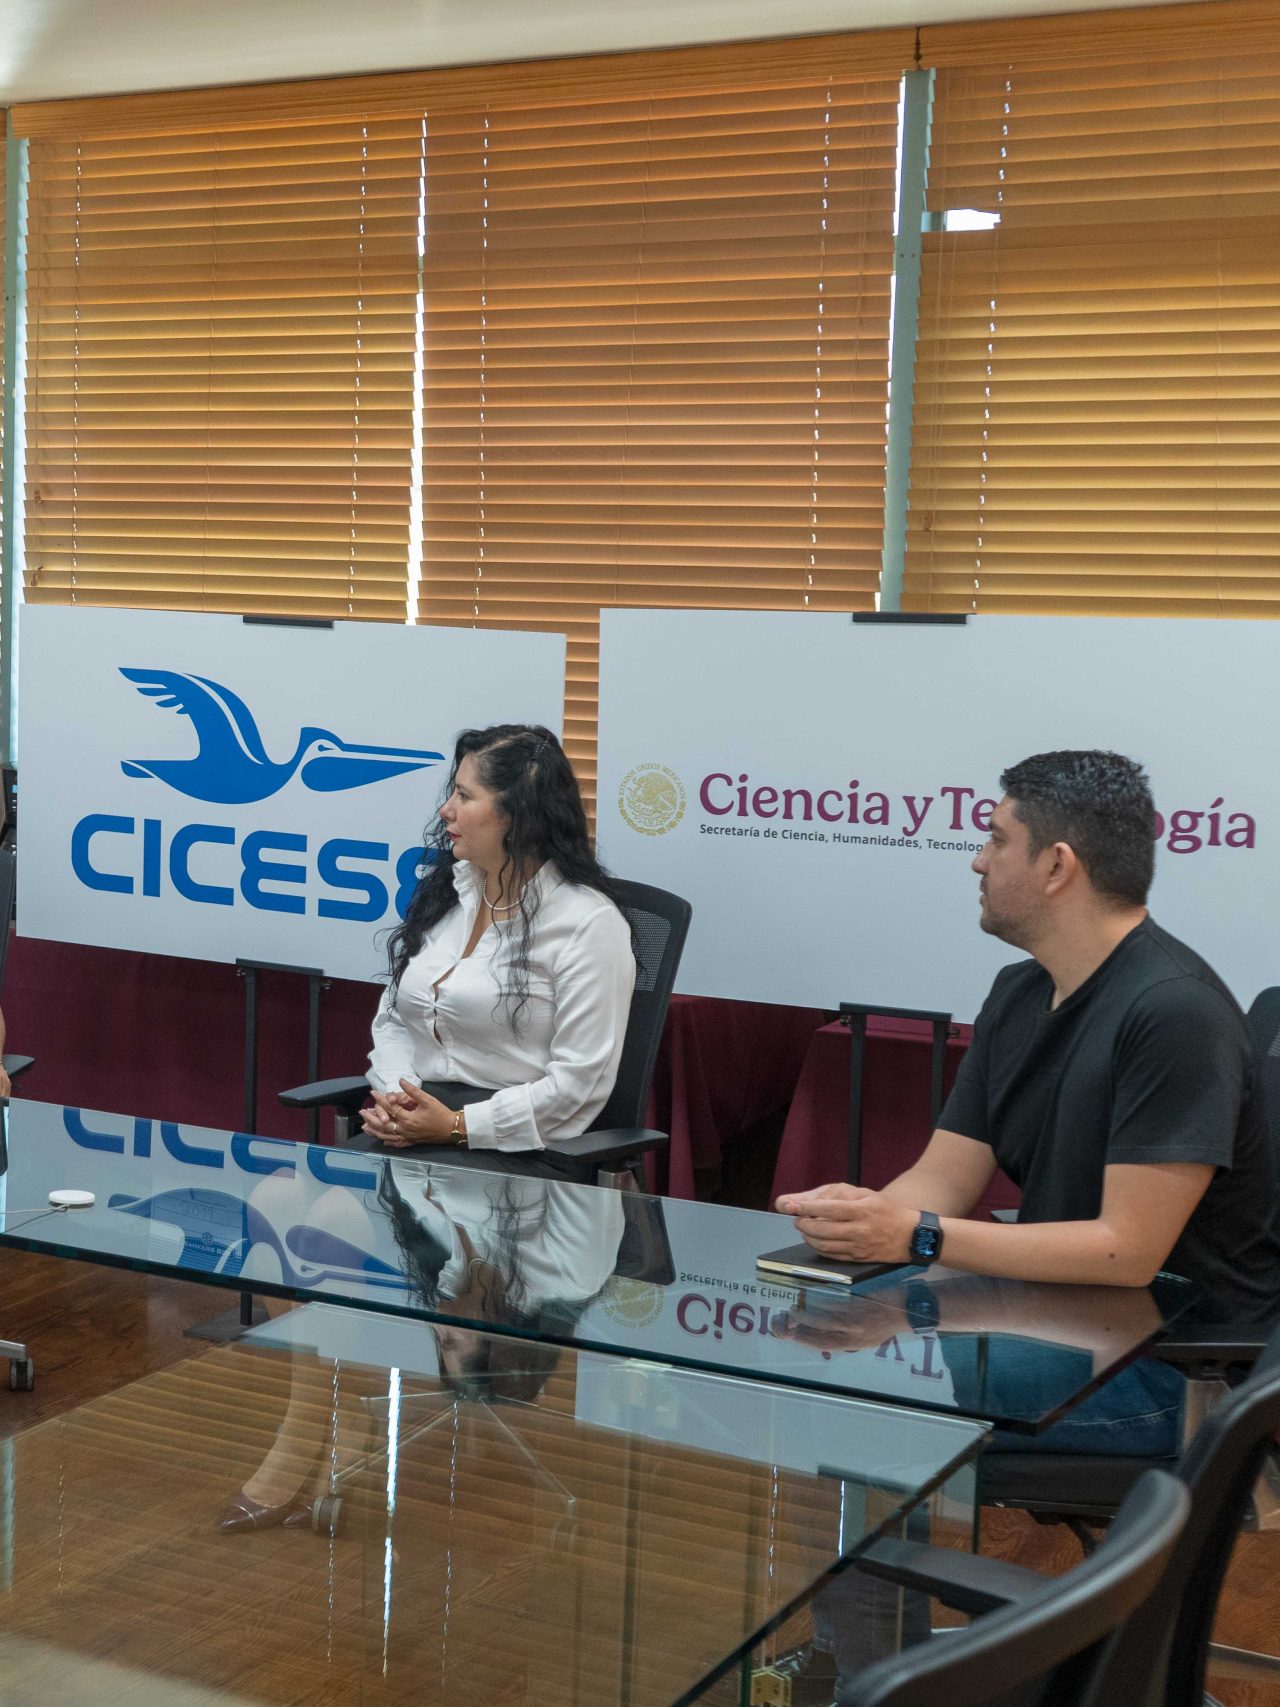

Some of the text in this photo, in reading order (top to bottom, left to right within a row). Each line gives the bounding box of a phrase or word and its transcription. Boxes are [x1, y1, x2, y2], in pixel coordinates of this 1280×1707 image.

[699, 772, 890, 826] Ciencia
[902, 795, 934, 837] y
[699, 823, 984, 855] Secretaría de Ciencia, Humanidades, Tecnolog
